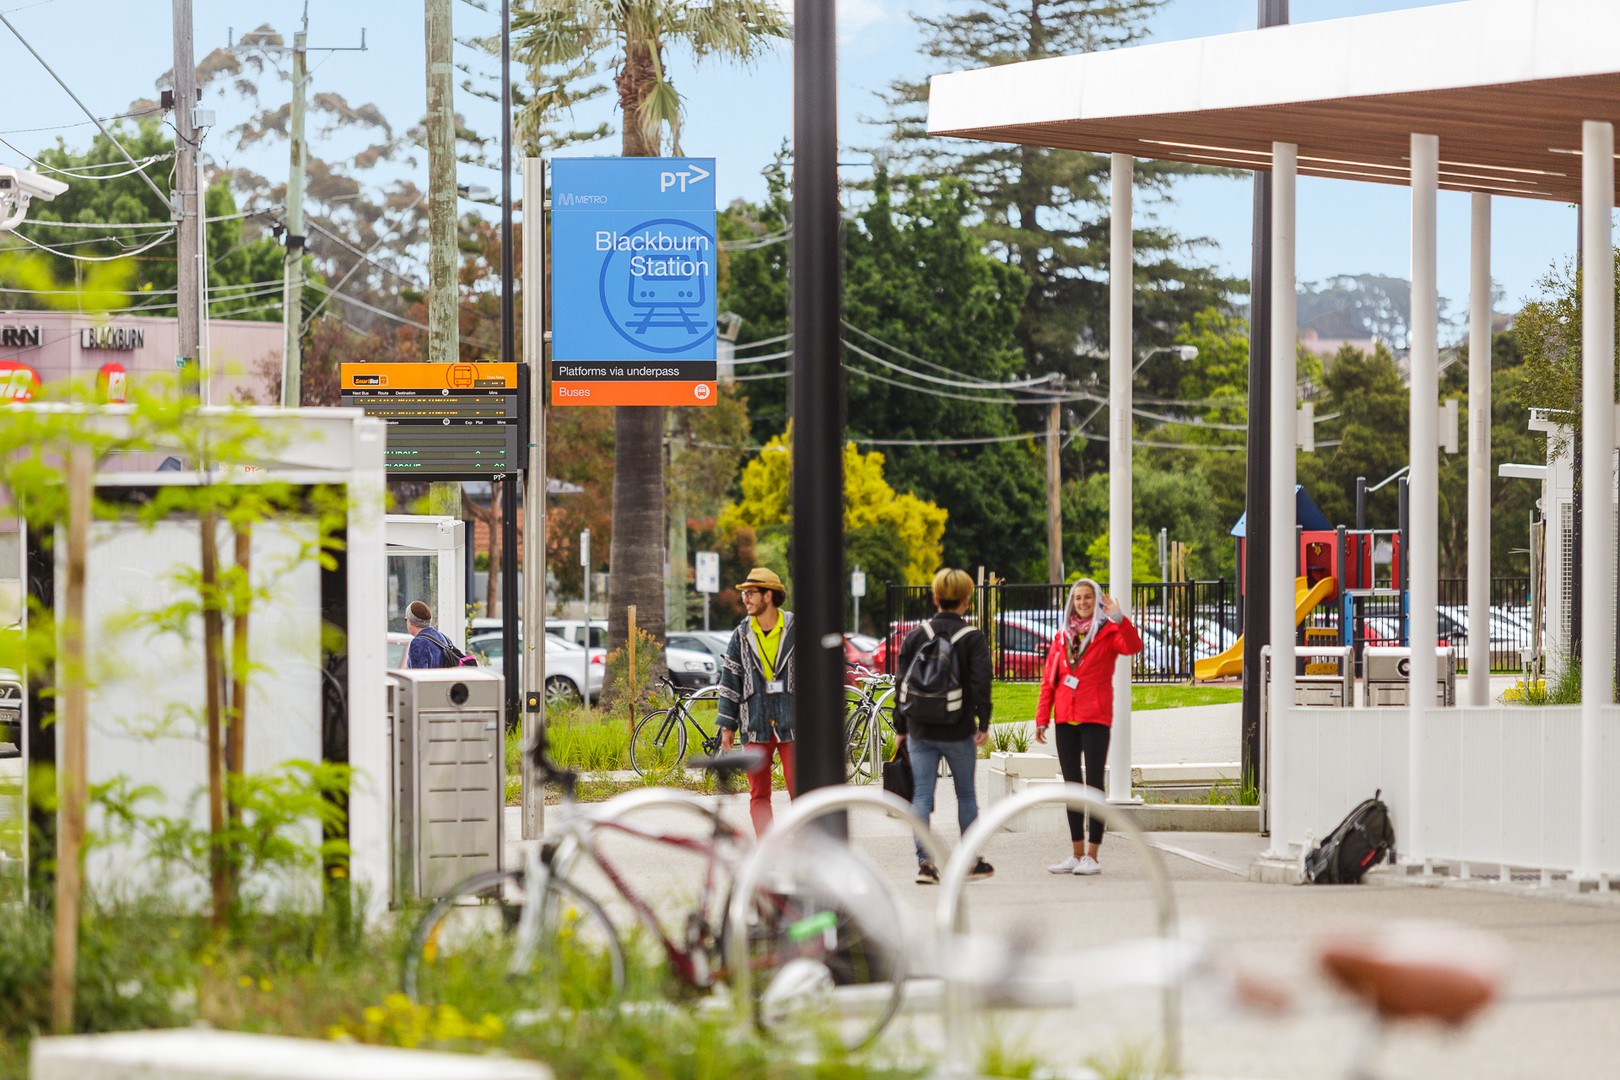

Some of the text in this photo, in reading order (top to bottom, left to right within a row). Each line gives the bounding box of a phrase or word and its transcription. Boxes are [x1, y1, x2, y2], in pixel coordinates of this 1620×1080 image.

[660, 172, 691, 193] PT
[575, 195, 608, 205] METRO
[595, 231, 709, 251] Blackburn
[630, 256, 709, 277] Station
[81, 327, 144, 350] BLACKBURN
[559, 366, 680, 378] Platforms via underpass
[559, 387, 591, 397] Buses
